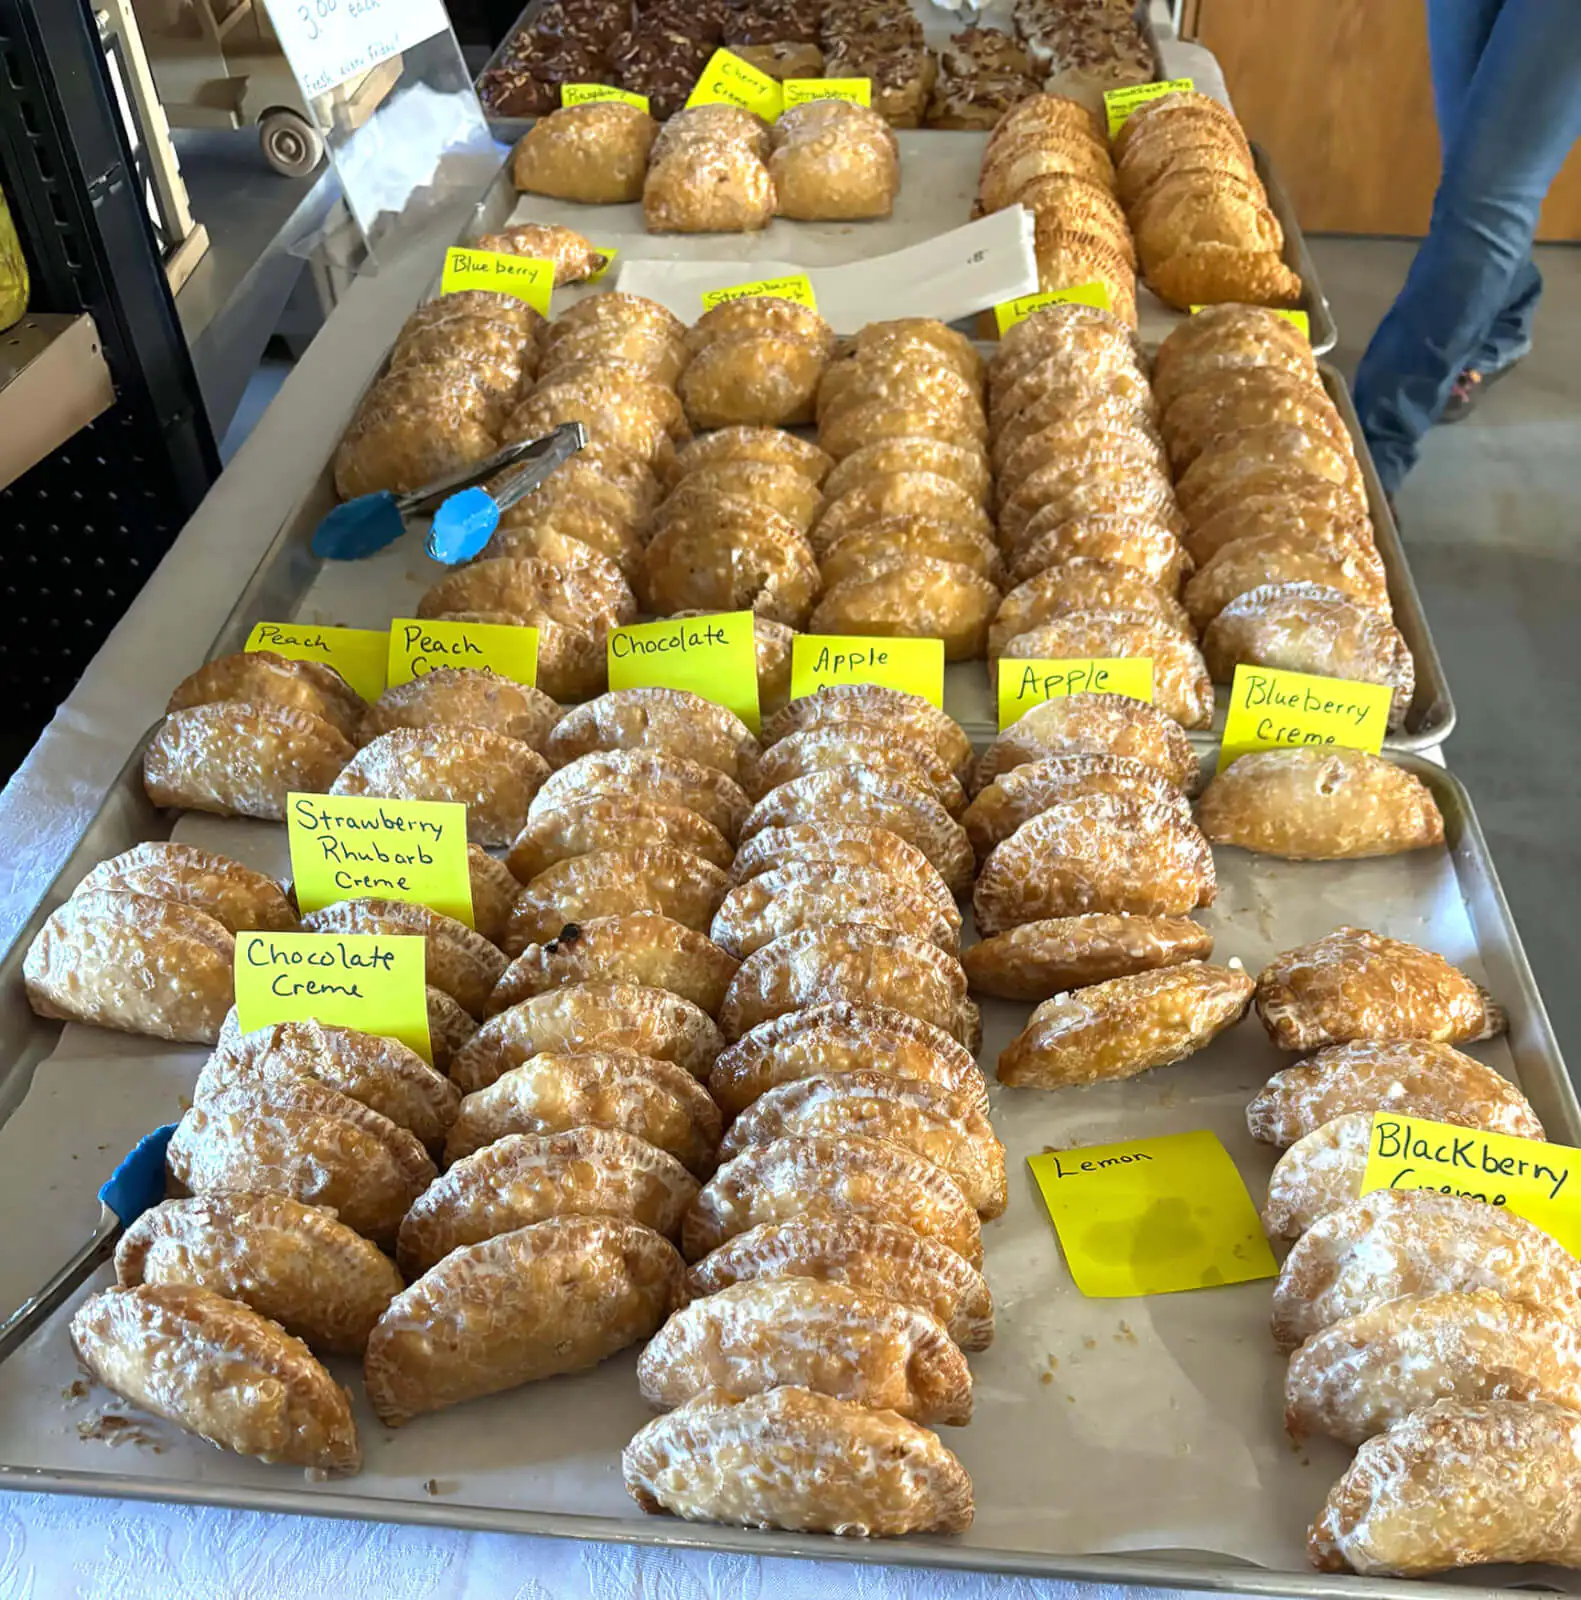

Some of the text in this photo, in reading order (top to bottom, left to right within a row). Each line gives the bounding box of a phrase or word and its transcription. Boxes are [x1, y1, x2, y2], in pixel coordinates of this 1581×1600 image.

[721, 62, 768, 95] Cherry
[258, 626, 331, 653] Peach
[404, 625, 483, 655] Peach
[611, 625, 729, 659] Chocolate
[813, 646, 889, 674] Apple
[1016, 661, 1109, 700] Apple
[1245, 675, 1370, 725] Blueberry
[1256, 718, 1335, 745] Creme
[295, 800, 443, 842] Strawberry
[317, 834, 434, 866] Rhubarb
[334, 870, 412, 891] Creme
[247, 938, 395, 971] Chocolate
[271, 973, 364, 999] Creme
[1053, 1151, 1153, 1179] Lemon
